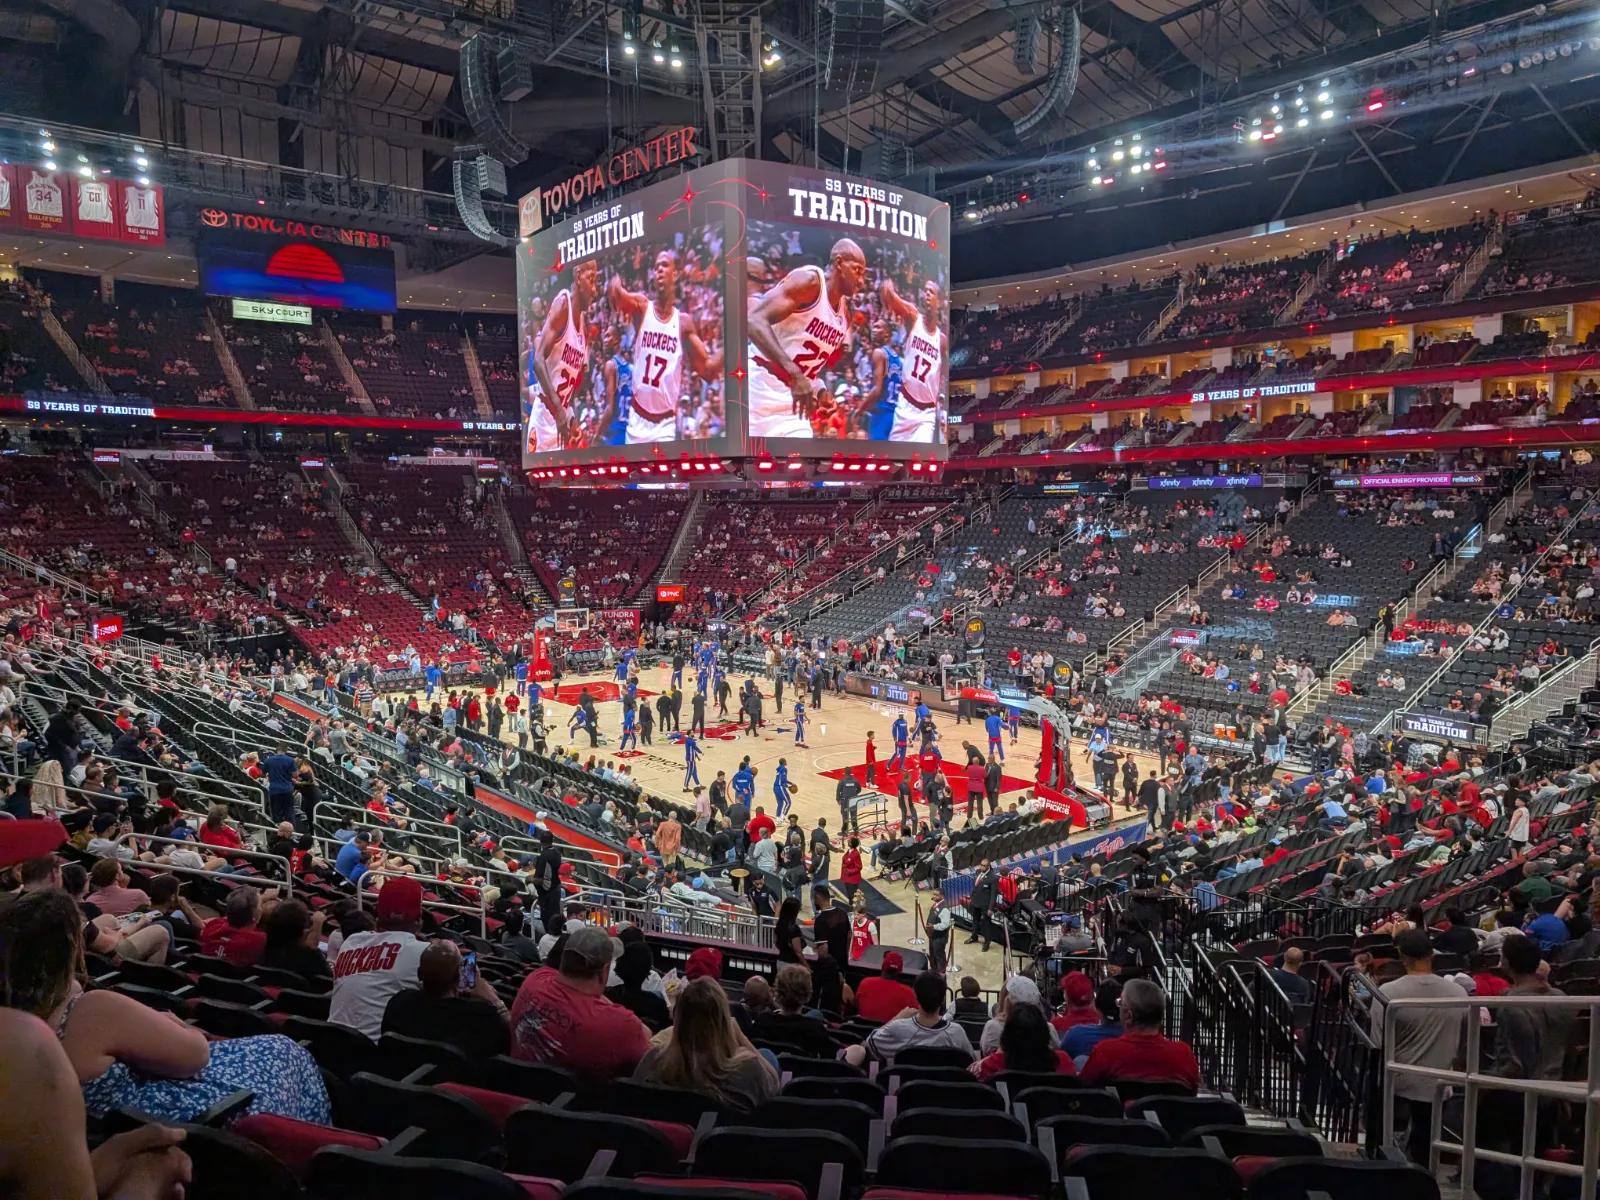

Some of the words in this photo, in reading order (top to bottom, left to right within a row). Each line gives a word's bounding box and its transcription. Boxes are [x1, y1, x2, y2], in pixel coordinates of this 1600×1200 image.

[543, 165, 605, 216] TOYOTA
[608, 126, 698, 185] CENTER
[35, 190, 52, 202] 34
[825, 178, 841, 193] 59
[846, 182, 886, 202] YEARS
[888, 192, 903, 206] OF
[584, 209, 608, 229] YEARS
[610, 204, 622, 217] OF
[788, 188, 928, 242] TRADITION
[311, 225, 391, 248] CNTER
[558, 211, 645, 265] TRADITION
[251, 305, 274, 315] SKY
[276, 309, 310, 318] COURT
[642, 353, 668, 388] 17
[911, 355, 932, 383] 17
[1207, 389, 1239, 400] YEARS
[1243, 388, 1257, 397] OF
[1260, 382, 1316, 396] TRADITION
[27, 401, 40, 410] 59
[44, 402, 79, 412] YEARS
[84, 404, 96, 413] OF
[101, 405, 154, 417] TRADITION
[476, 422, 503, 430] YEARS
[1159, 479, 1181, 488] xfinity
[1192, 478, 1214, 487] xfinity
[1226, 477, 1249, 486] xfinity
[1452, 475, 1475, 483] reliant
[1406, 719, 1468, 739] TRADITION
